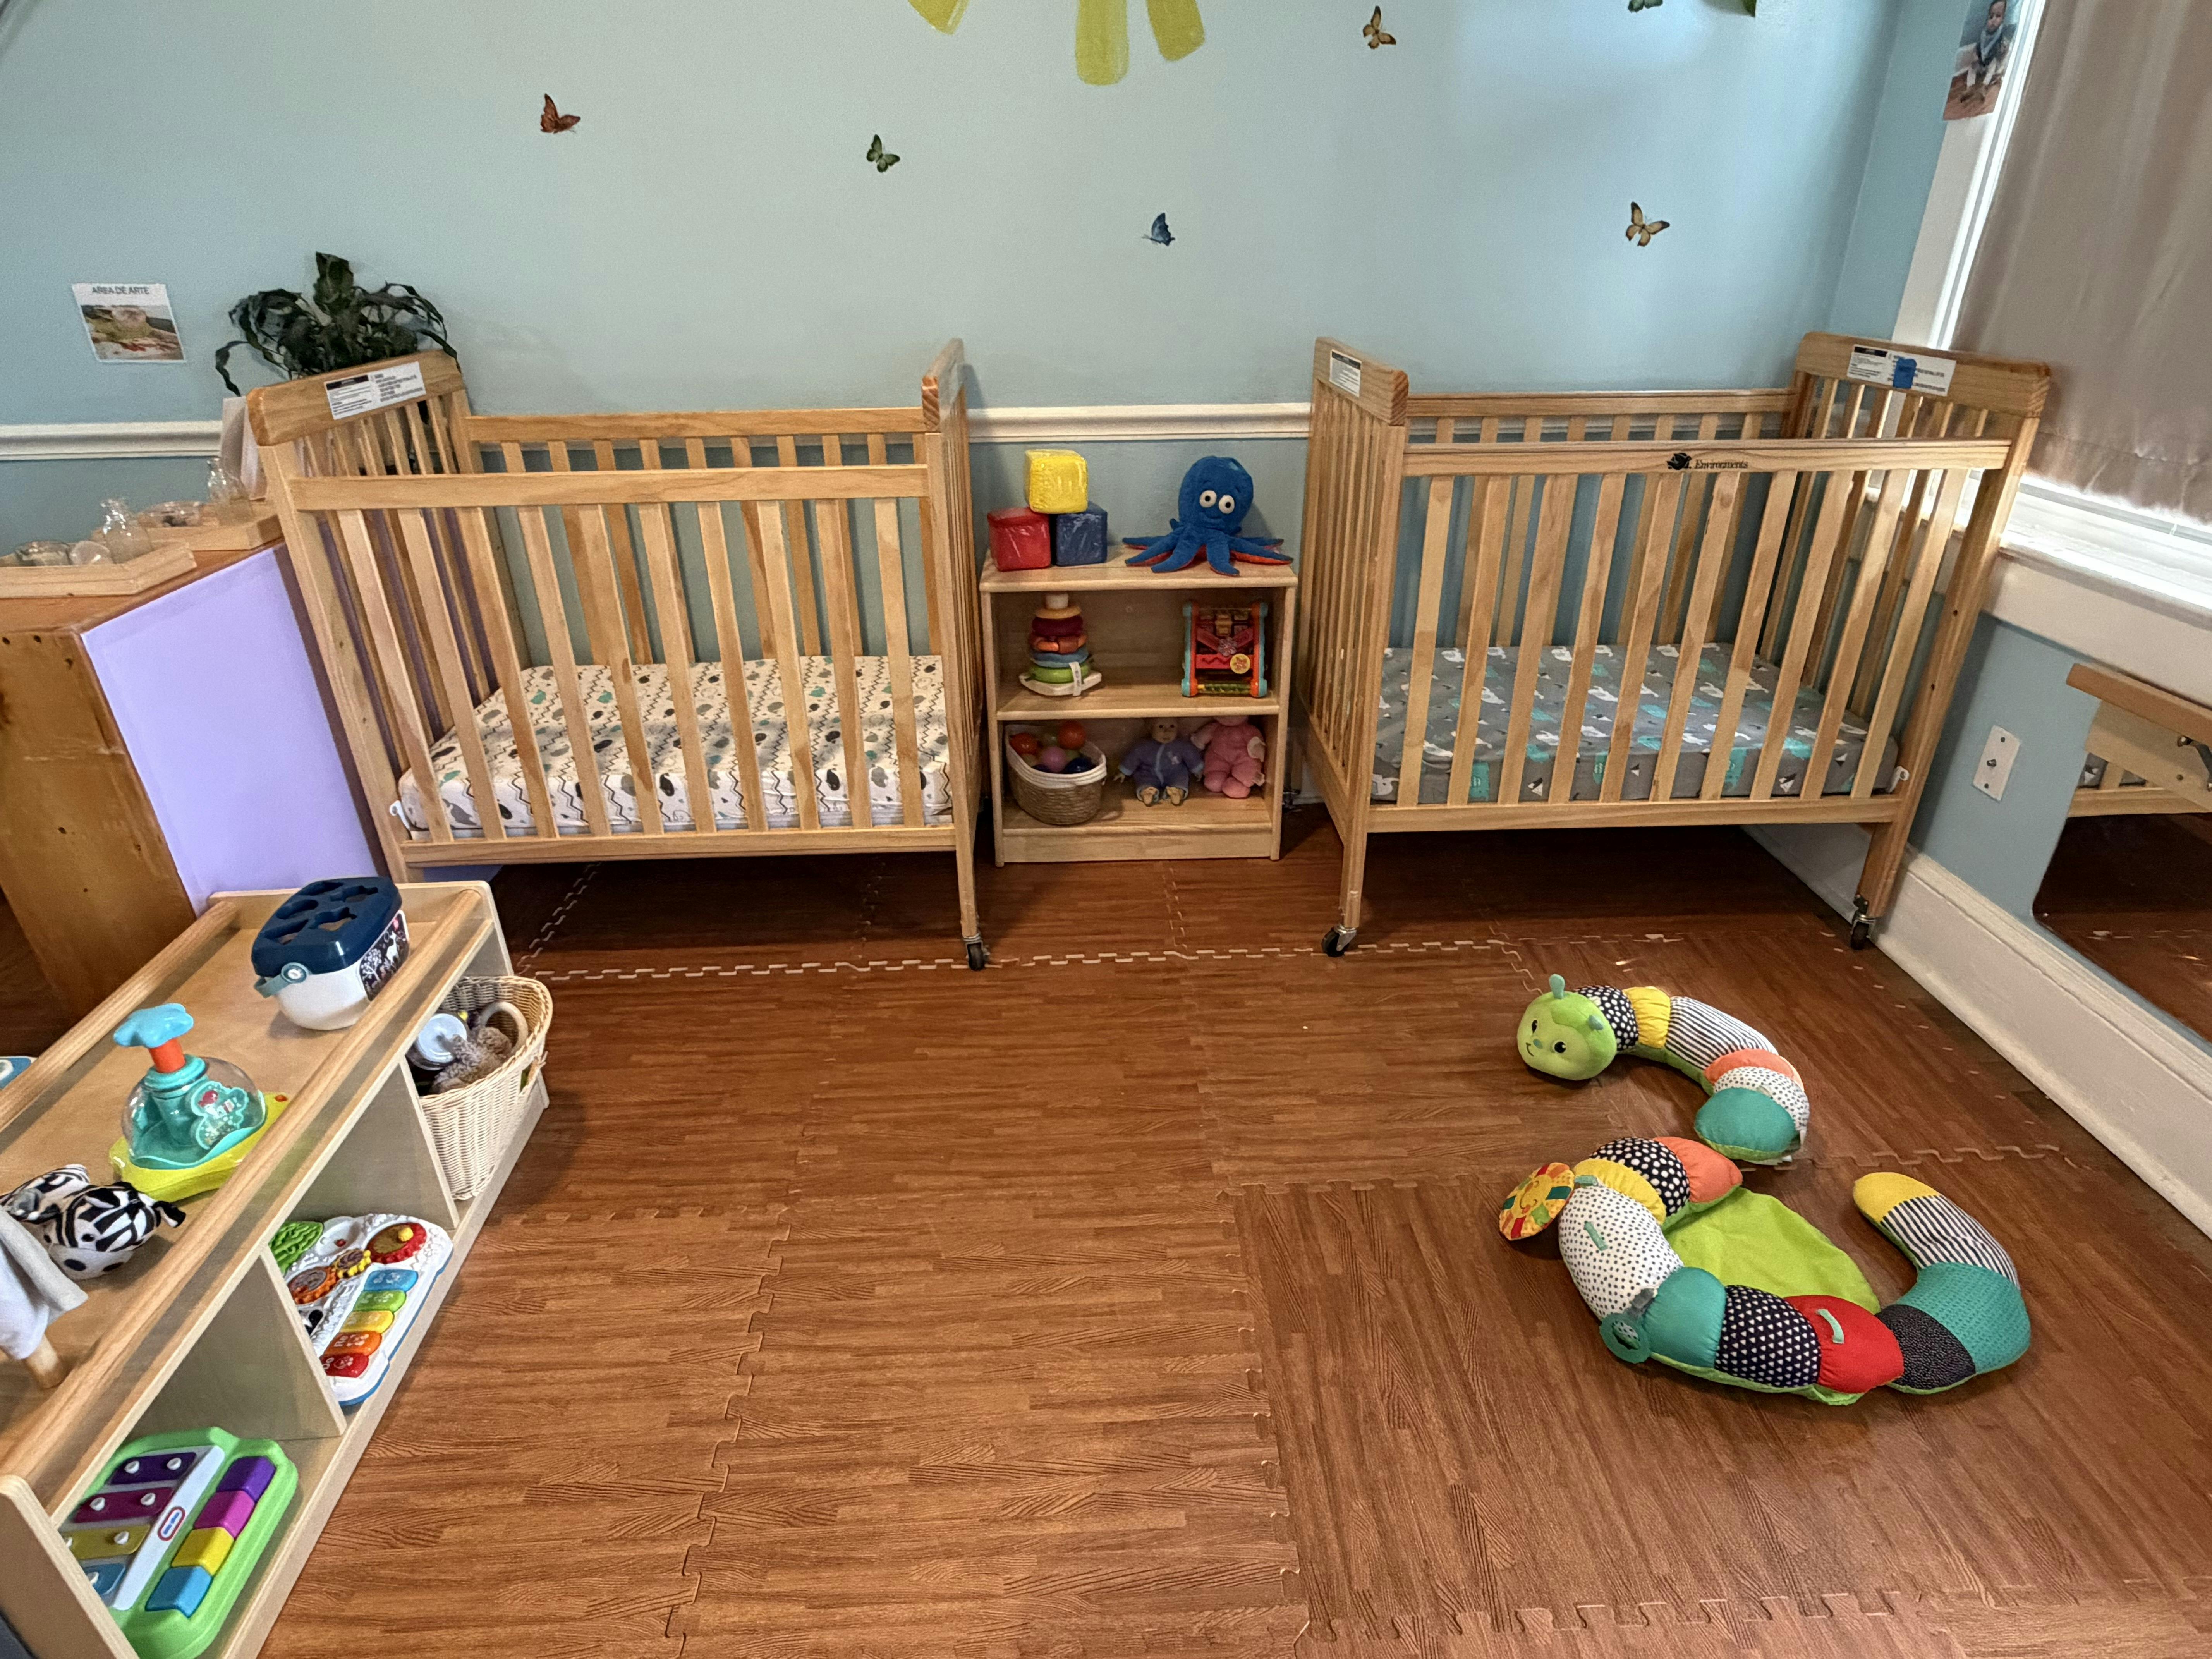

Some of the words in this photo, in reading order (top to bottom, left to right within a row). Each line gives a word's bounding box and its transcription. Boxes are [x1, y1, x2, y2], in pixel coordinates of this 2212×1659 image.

[92, 286, 114, 294] AREA
[115, 286, 127, 294] DE
[129, 286, 149, 294] ARTE
